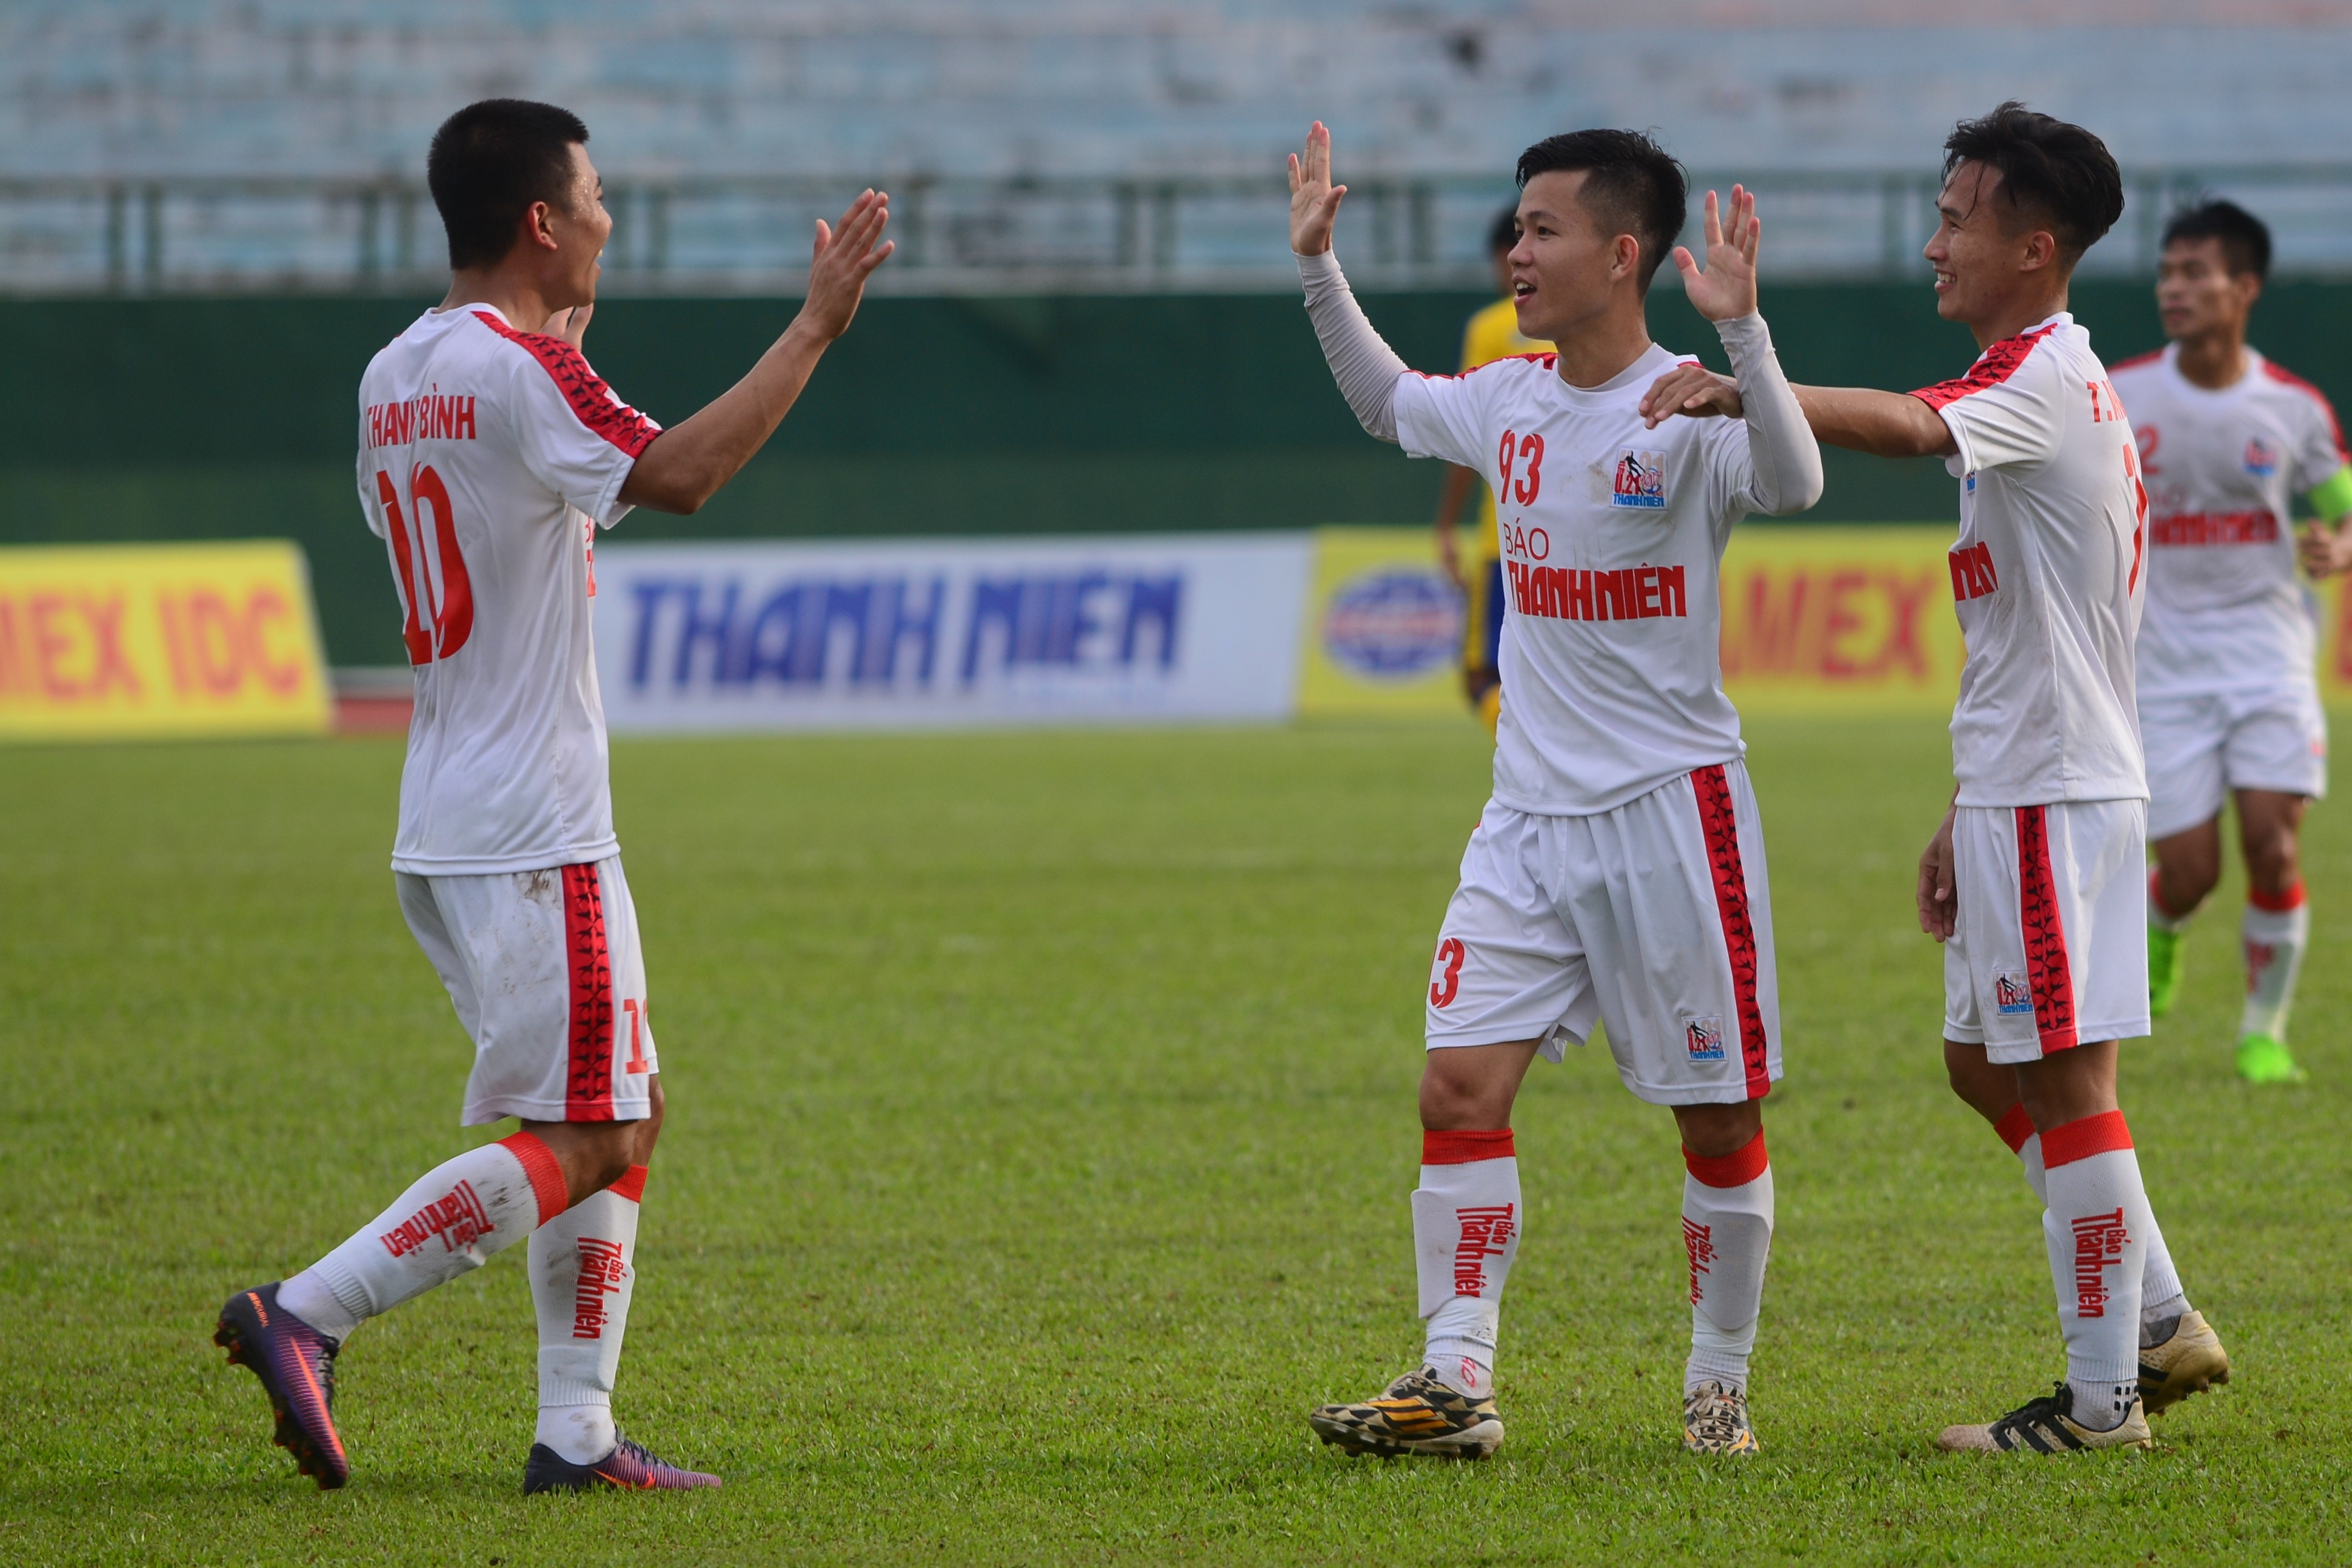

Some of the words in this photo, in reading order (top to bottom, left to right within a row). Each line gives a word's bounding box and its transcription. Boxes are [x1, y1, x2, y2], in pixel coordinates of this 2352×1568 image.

[419, 382, 476, 439] BÌNH
[1498, 429, 1545, 507] 93
[376, 461, 474, 666] 10
[1503, 517, 1549, 561] BÁO
[155, 585, 305, 700] IDC
[627, 575, 949, 690] THANH
[1720, 567, 1939, 682] MEX
[1428, 938, 1465, 1009] 3
[624, 998, 648, 1075] 1
[1491, 1221, 1516, 1245] Báo
[2105, 1229, 2132, 1254] Báo
[608, 1259, 627, 1283] Báo
